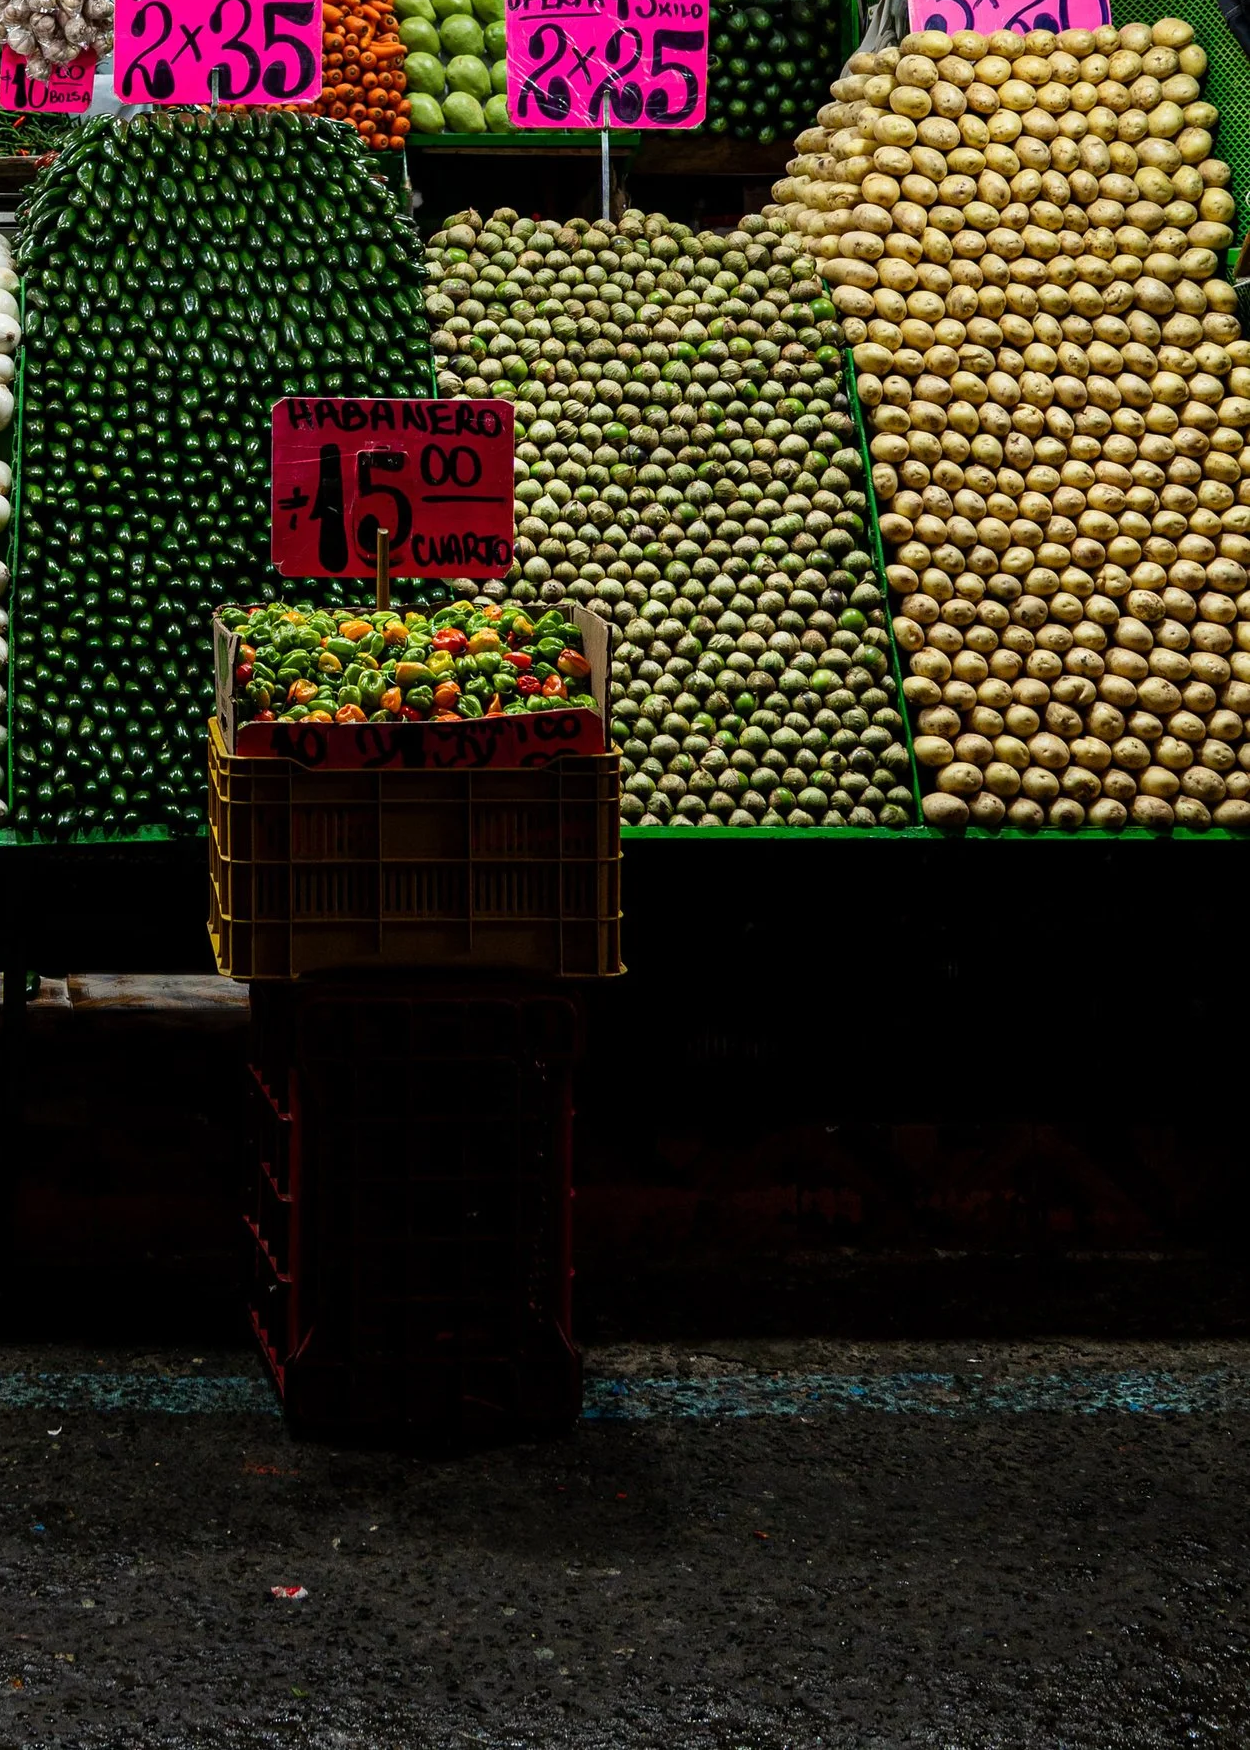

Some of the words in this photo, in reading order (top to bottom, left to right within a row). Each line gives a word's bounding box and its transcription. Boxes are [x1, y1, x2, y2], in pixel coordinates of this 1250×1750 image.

[658, 3, 704, 19] KILO
[50, 90, 92, 106] BOLSA
[286, 399, 501, 437] HABANERO
[420, 443, 483, 488] 00
[411, 532, 512, 568] CUARTO
